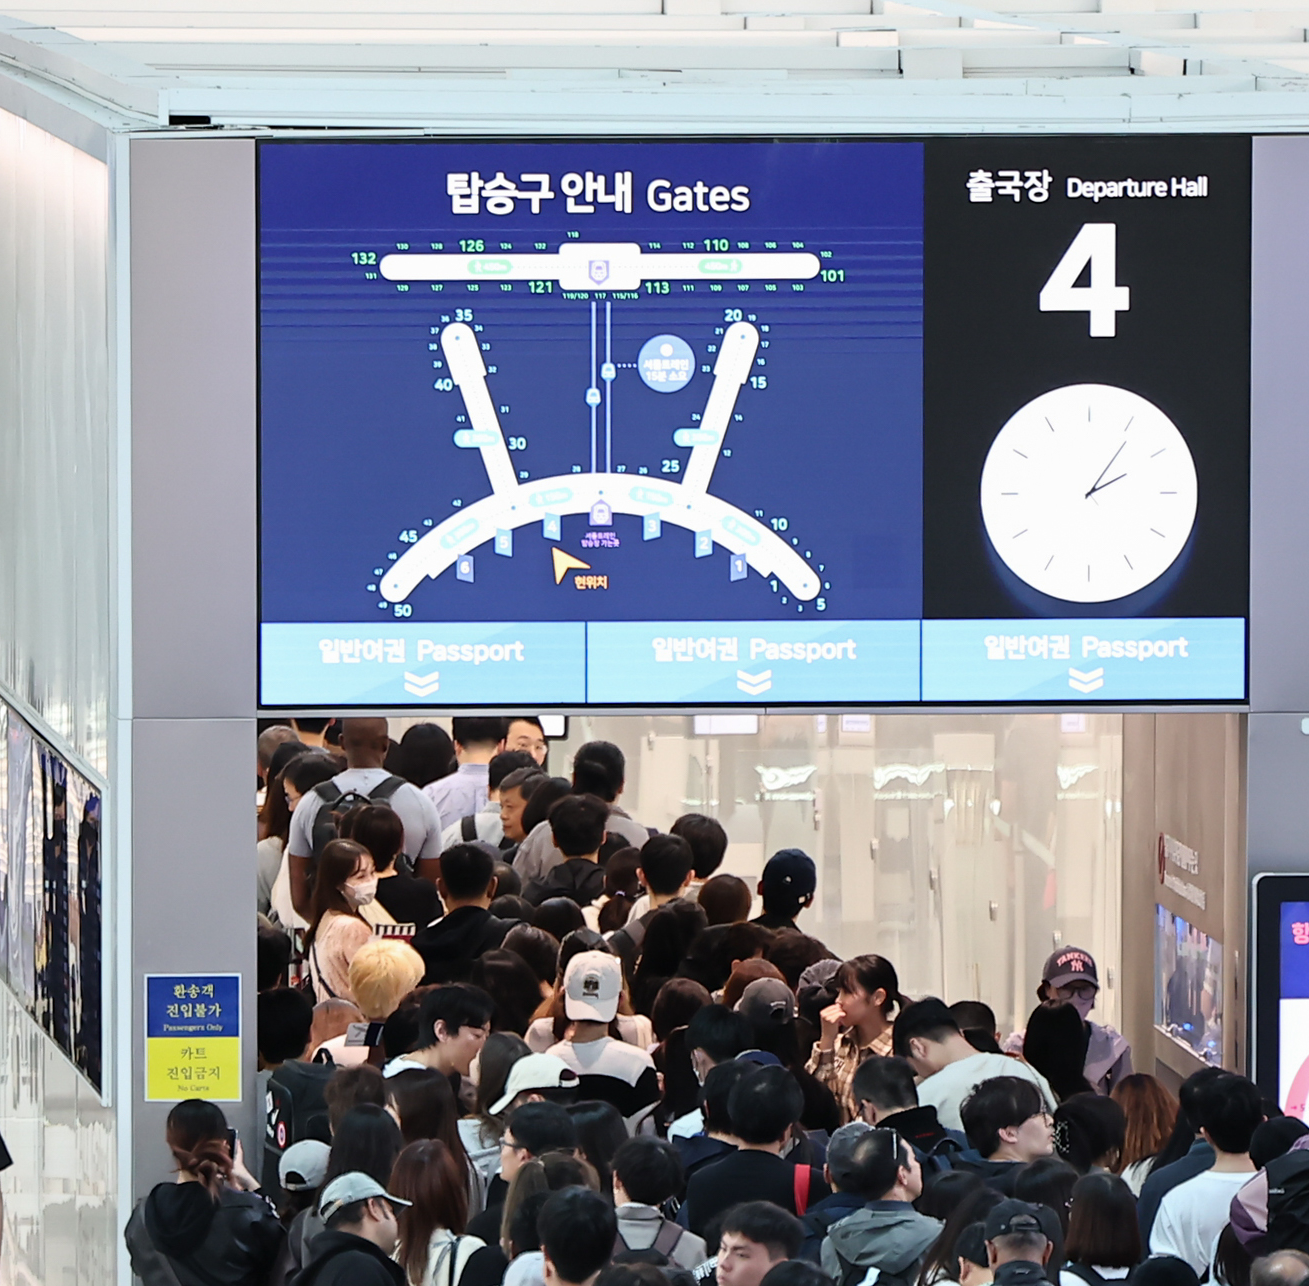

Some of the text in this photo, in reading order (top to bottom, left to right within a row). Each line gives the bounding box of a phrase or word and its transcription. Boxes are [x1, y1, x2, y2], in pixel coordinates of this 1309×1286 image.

[966, 169, 1208, 203] 출국장 Departure Hall
[446, 172, 750, 215] 탑승구 안내 Gates
[430, 242, 443, 250] 128
[459, 239, 485, 252] 126
[703, 238, 729, 252] 110
[351, 252, 377, 265] 132
[820, 250, 832, 258] 102
[365, 272, 377, 280] 131
[820, 269, 844, 282] 101
[1039, 223, 1130, 337] 4
[396, 284, 409, 292] 129
[431, 284, 443, 292] 127
[466, 284, 479, 292] 125
[528, 280, 552, 294] 121
[645, 281, 670, 294] 113
[682, 284, 695, 292] 111
[709, 284, 722, 292] 109
[737, 284, 750, 292] 107
[562, 292, 589, 300] 119/120
[455, 308, 473, 322] 35
[724, 308, 743, 323] 20
[747, 314, 757, 322] 19
[430, 326, 440, 335] 37
[474, 324, 484, 332] 34
[714, 327, 724, 335] 21
[760, 340, 770, 348] 17
[434, 377, 454, 392] 40
[750, 375, 767, 389] 15
[500, 405, 510, 414] 31
[456, 415, 466, 423] 41
[508, 436, 527, 450] 30
[617, 465, 626, 473] 27
[661, 459, 680, 473] 25
[754, 509, 764, 517] 11
[547, 520, 557, 533] 4
[648, 520, 657, 532] 3
[769, 517, 788, 532] 10
[398, 529, 419, 544] 45
[499, 536, 509, 548] 5
[700, 537, 708, 549] 2
[374, 568, 384, 576] 47
[460, 561, 470, 574] 6
[735, 560, 743, 572] 1
[818, 564, 825, 572] 7
[574, 575, 608, 590] 현위치
[770, 579, 778, 593] 1
[394, 603, 412, 617] 50
[816, 597, 826, 611] 5
[319, 638, 525, 665] 일반여권 Passport
[651, 637, 857, 664] 일반여권 Passport
[984, 635, 1190, 661] 일반여권 Passport
[173, 984, 214, 999] 환송객
[166, 1003, 222, 1018] 진입불가
[163, 1023, 224, 1032] Passengers Only
[181, 1047, 207, 1060] 카트
[167, 1066, 221, 1080] 진입금지
